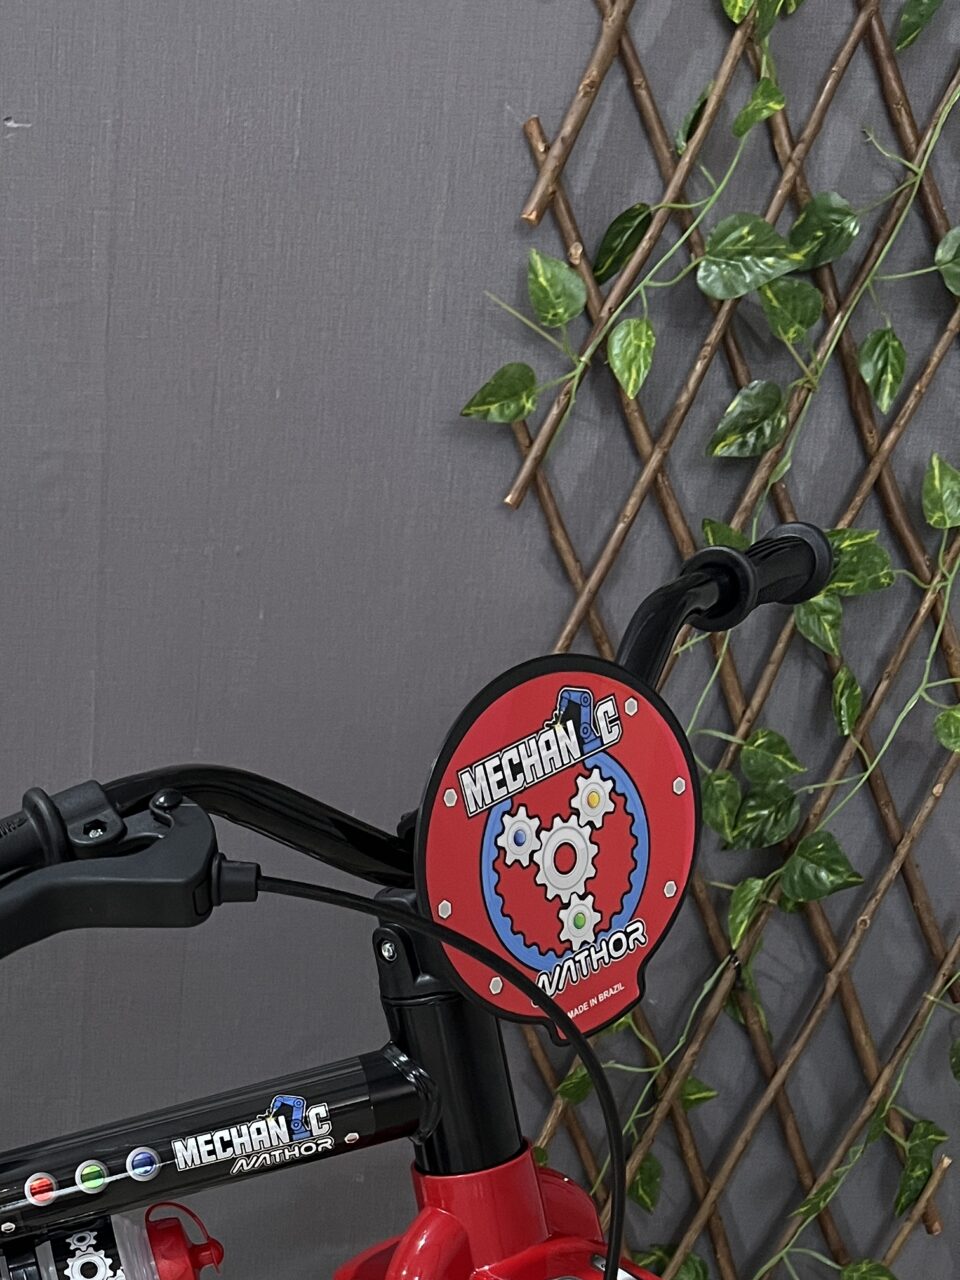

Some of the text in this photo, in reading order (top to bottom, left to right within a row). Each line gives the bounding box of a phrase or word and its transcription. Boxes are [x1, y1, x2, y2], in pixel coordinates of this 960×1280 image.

[536, 919, 648, 998] NATHOR
[590, 997, 598, 1008] IN
[598, 983, 625, 1002] BRAZIL
[229, 1137, 334, 1175] NATHOR
